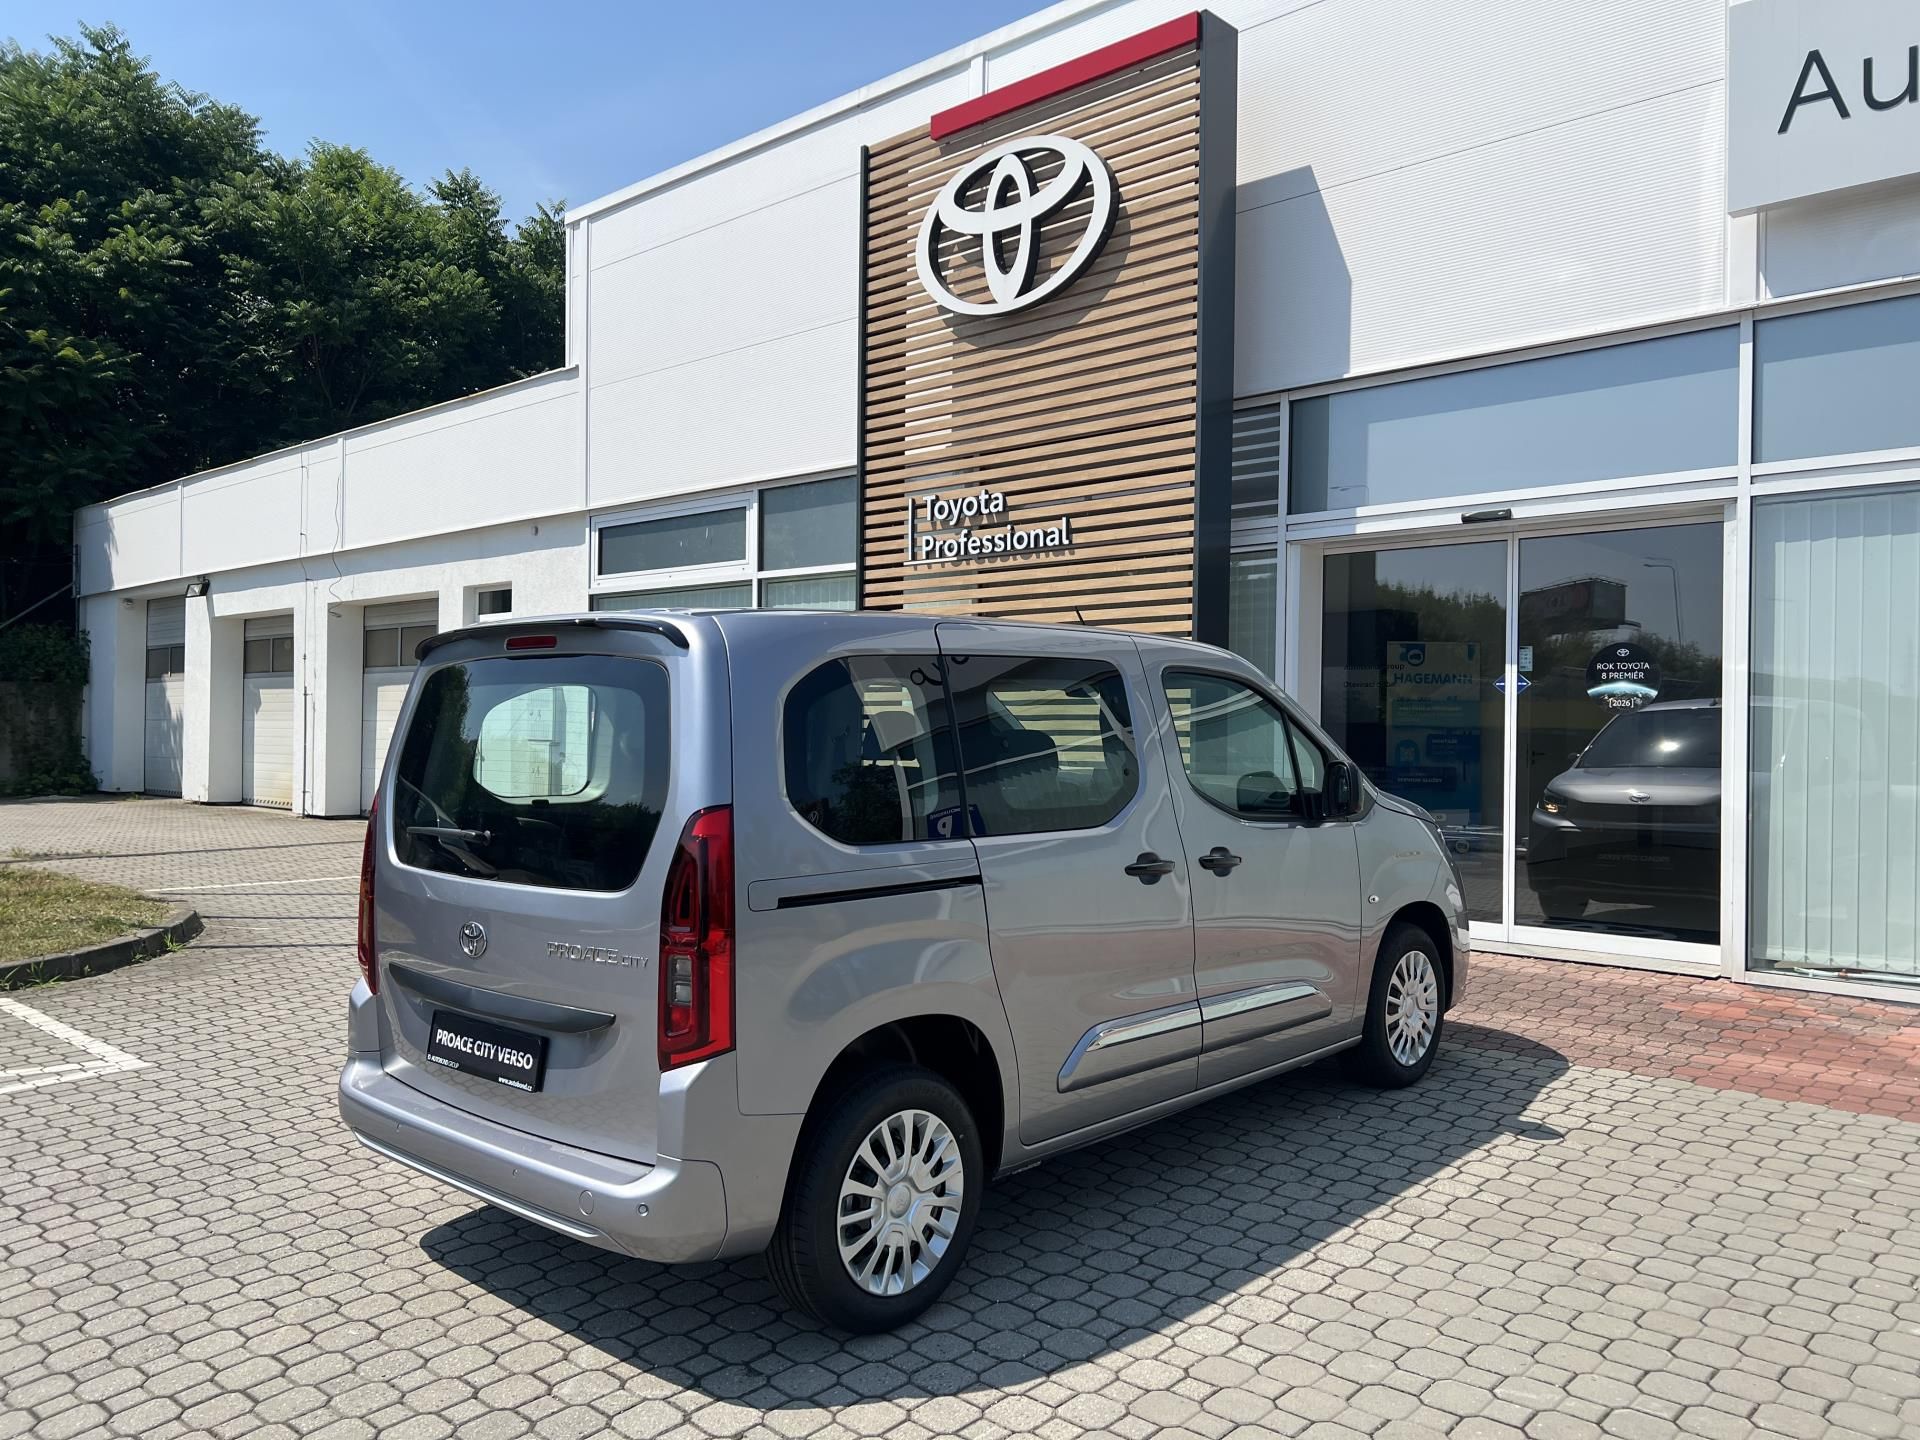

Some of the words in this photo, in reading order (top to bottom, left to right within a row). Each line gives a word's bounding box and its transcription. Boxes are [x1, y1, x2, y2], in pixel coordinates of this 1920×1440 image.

[922, 489, 1004, 526] Toyota
[921, 516, 1069, 560] Professional
[1393, 672, 1473, 686] HAGEMANN
[1596, 662, 1614, 670] ROK
[1617, 662, 1650, 670] TOYOTA
[1601, 672, 1607, 680] 8
[1609, 670, 1644, 680] PREMIÉR
[546, 941, 619, 965] PROACE
[621, 955, 649, 968] CITY
[435, 1028, 473, 1053] PROACE
[473, 1040, 497, 1060] CITY
[497, 1046, 533, 1070] VERSO
